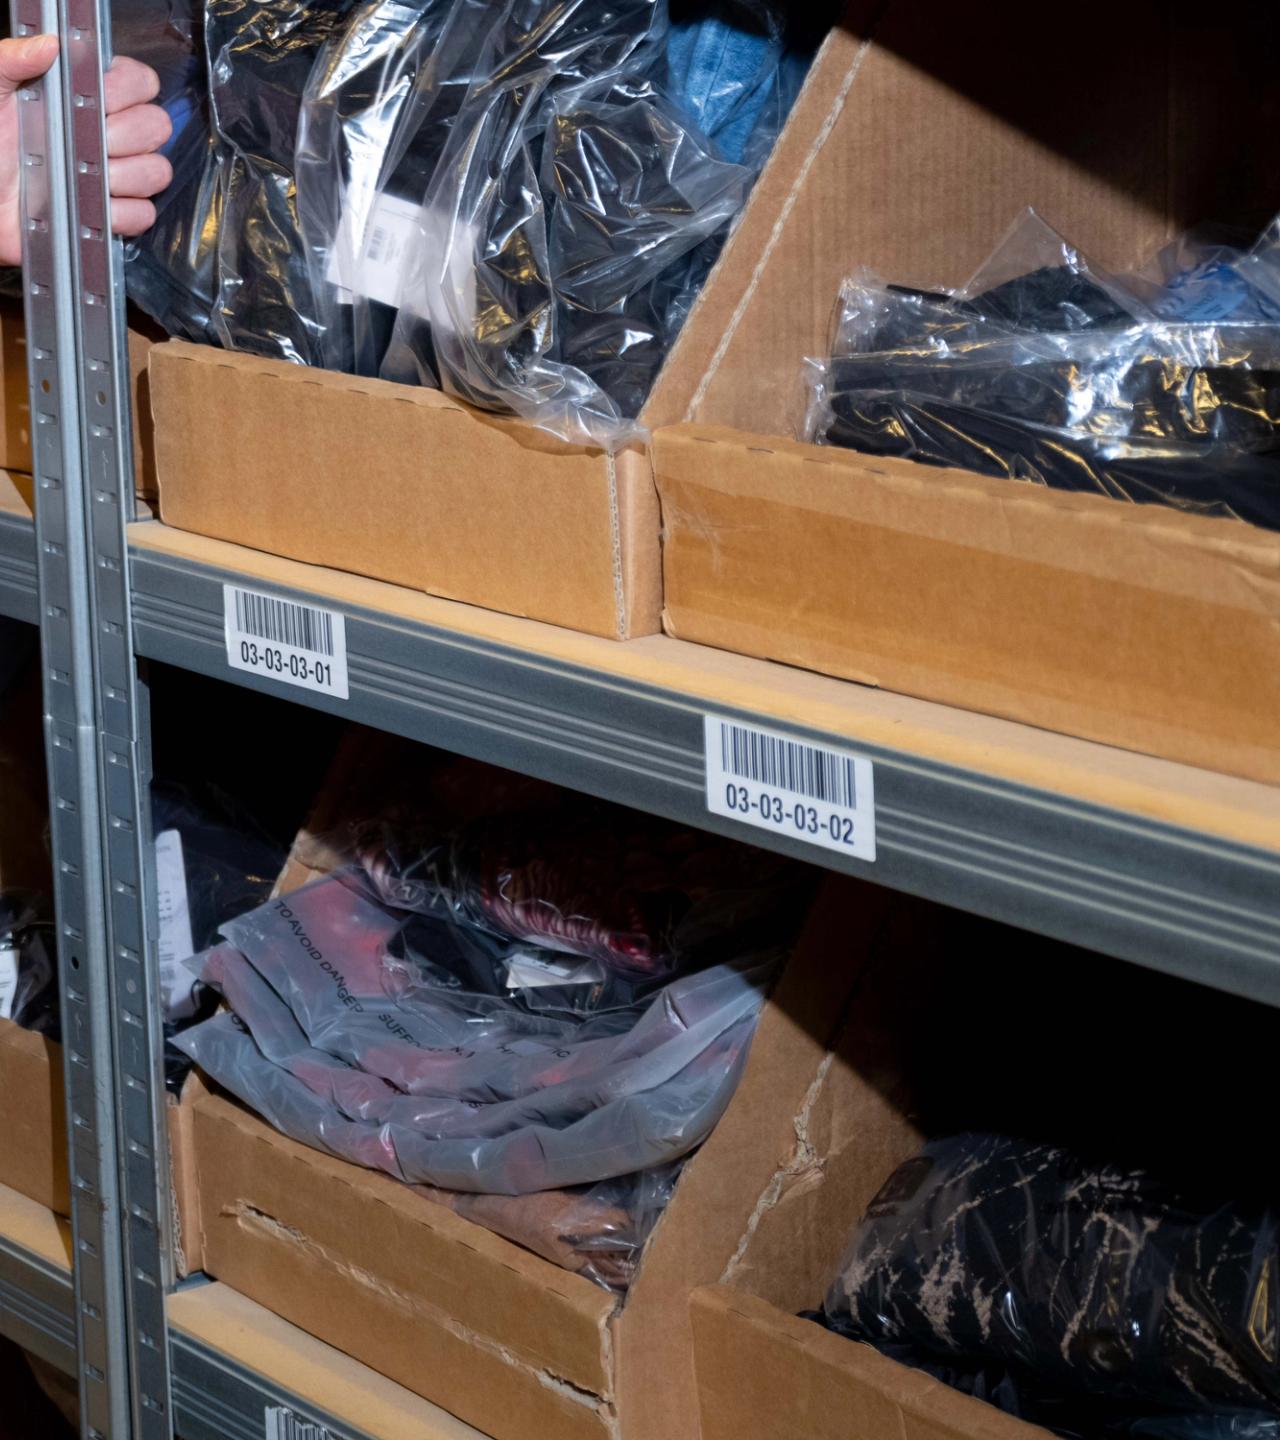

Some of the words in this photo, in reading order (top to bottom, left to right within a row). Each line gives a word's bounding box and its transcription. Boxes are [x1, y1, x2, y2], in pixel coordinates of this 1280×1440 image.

[240, 640, 332, 687] 03-03-03-01
[725, 782, 855, 846] 03-03-03-02
[274, 901, 293, 918] TO
[287, 920, 322, 960] AVOID
